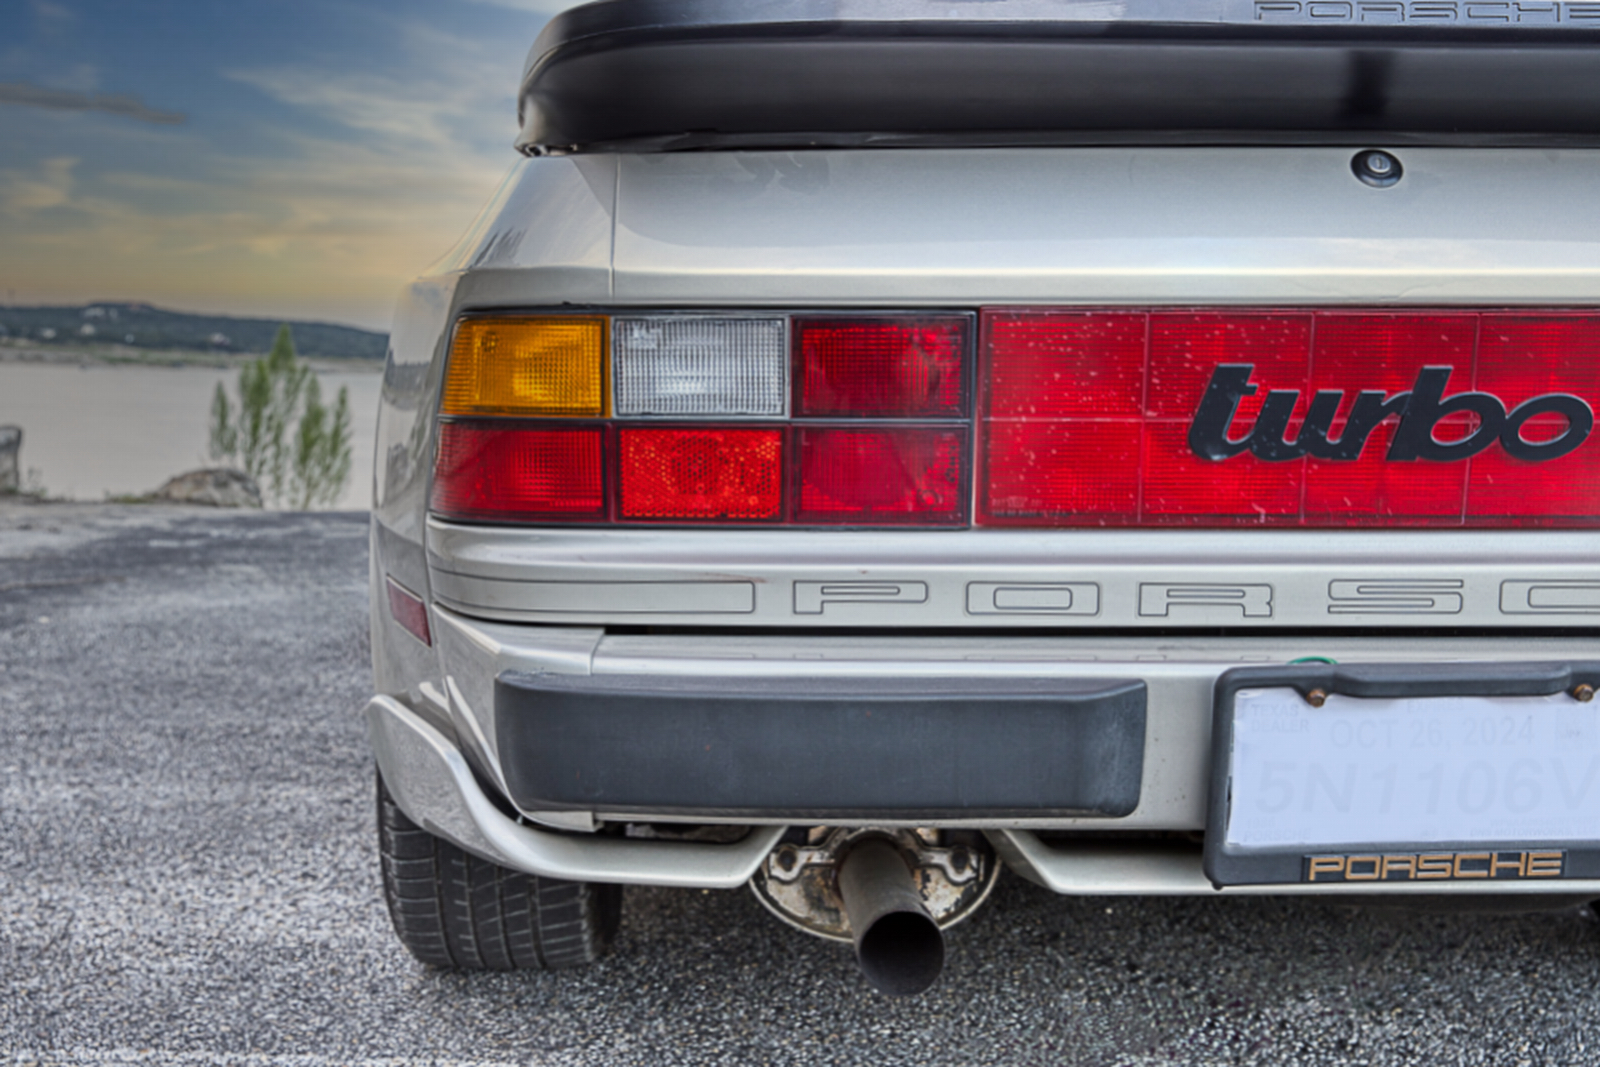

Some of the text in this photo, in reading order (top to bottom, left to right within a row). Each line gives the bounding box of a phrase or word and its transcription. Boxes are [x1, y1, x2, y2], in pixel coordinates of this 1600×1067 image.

[1255, 1, 1600, 22] PORSCHE
[1188, 363, 1593, 461] turbo
[1251, 703, 1299, 717] TEXAS
[1251, 719, 1310, 733] DEALER
[1329, 719, 1399, 749] OCT
[1461, 715, 1535, 746] 2024
[1255, 756, 1600, 815] 5N1106V
[1243, 827, 1311, 842] PORSCHE
[1309, 851, 1563, 880] PORSCHE
